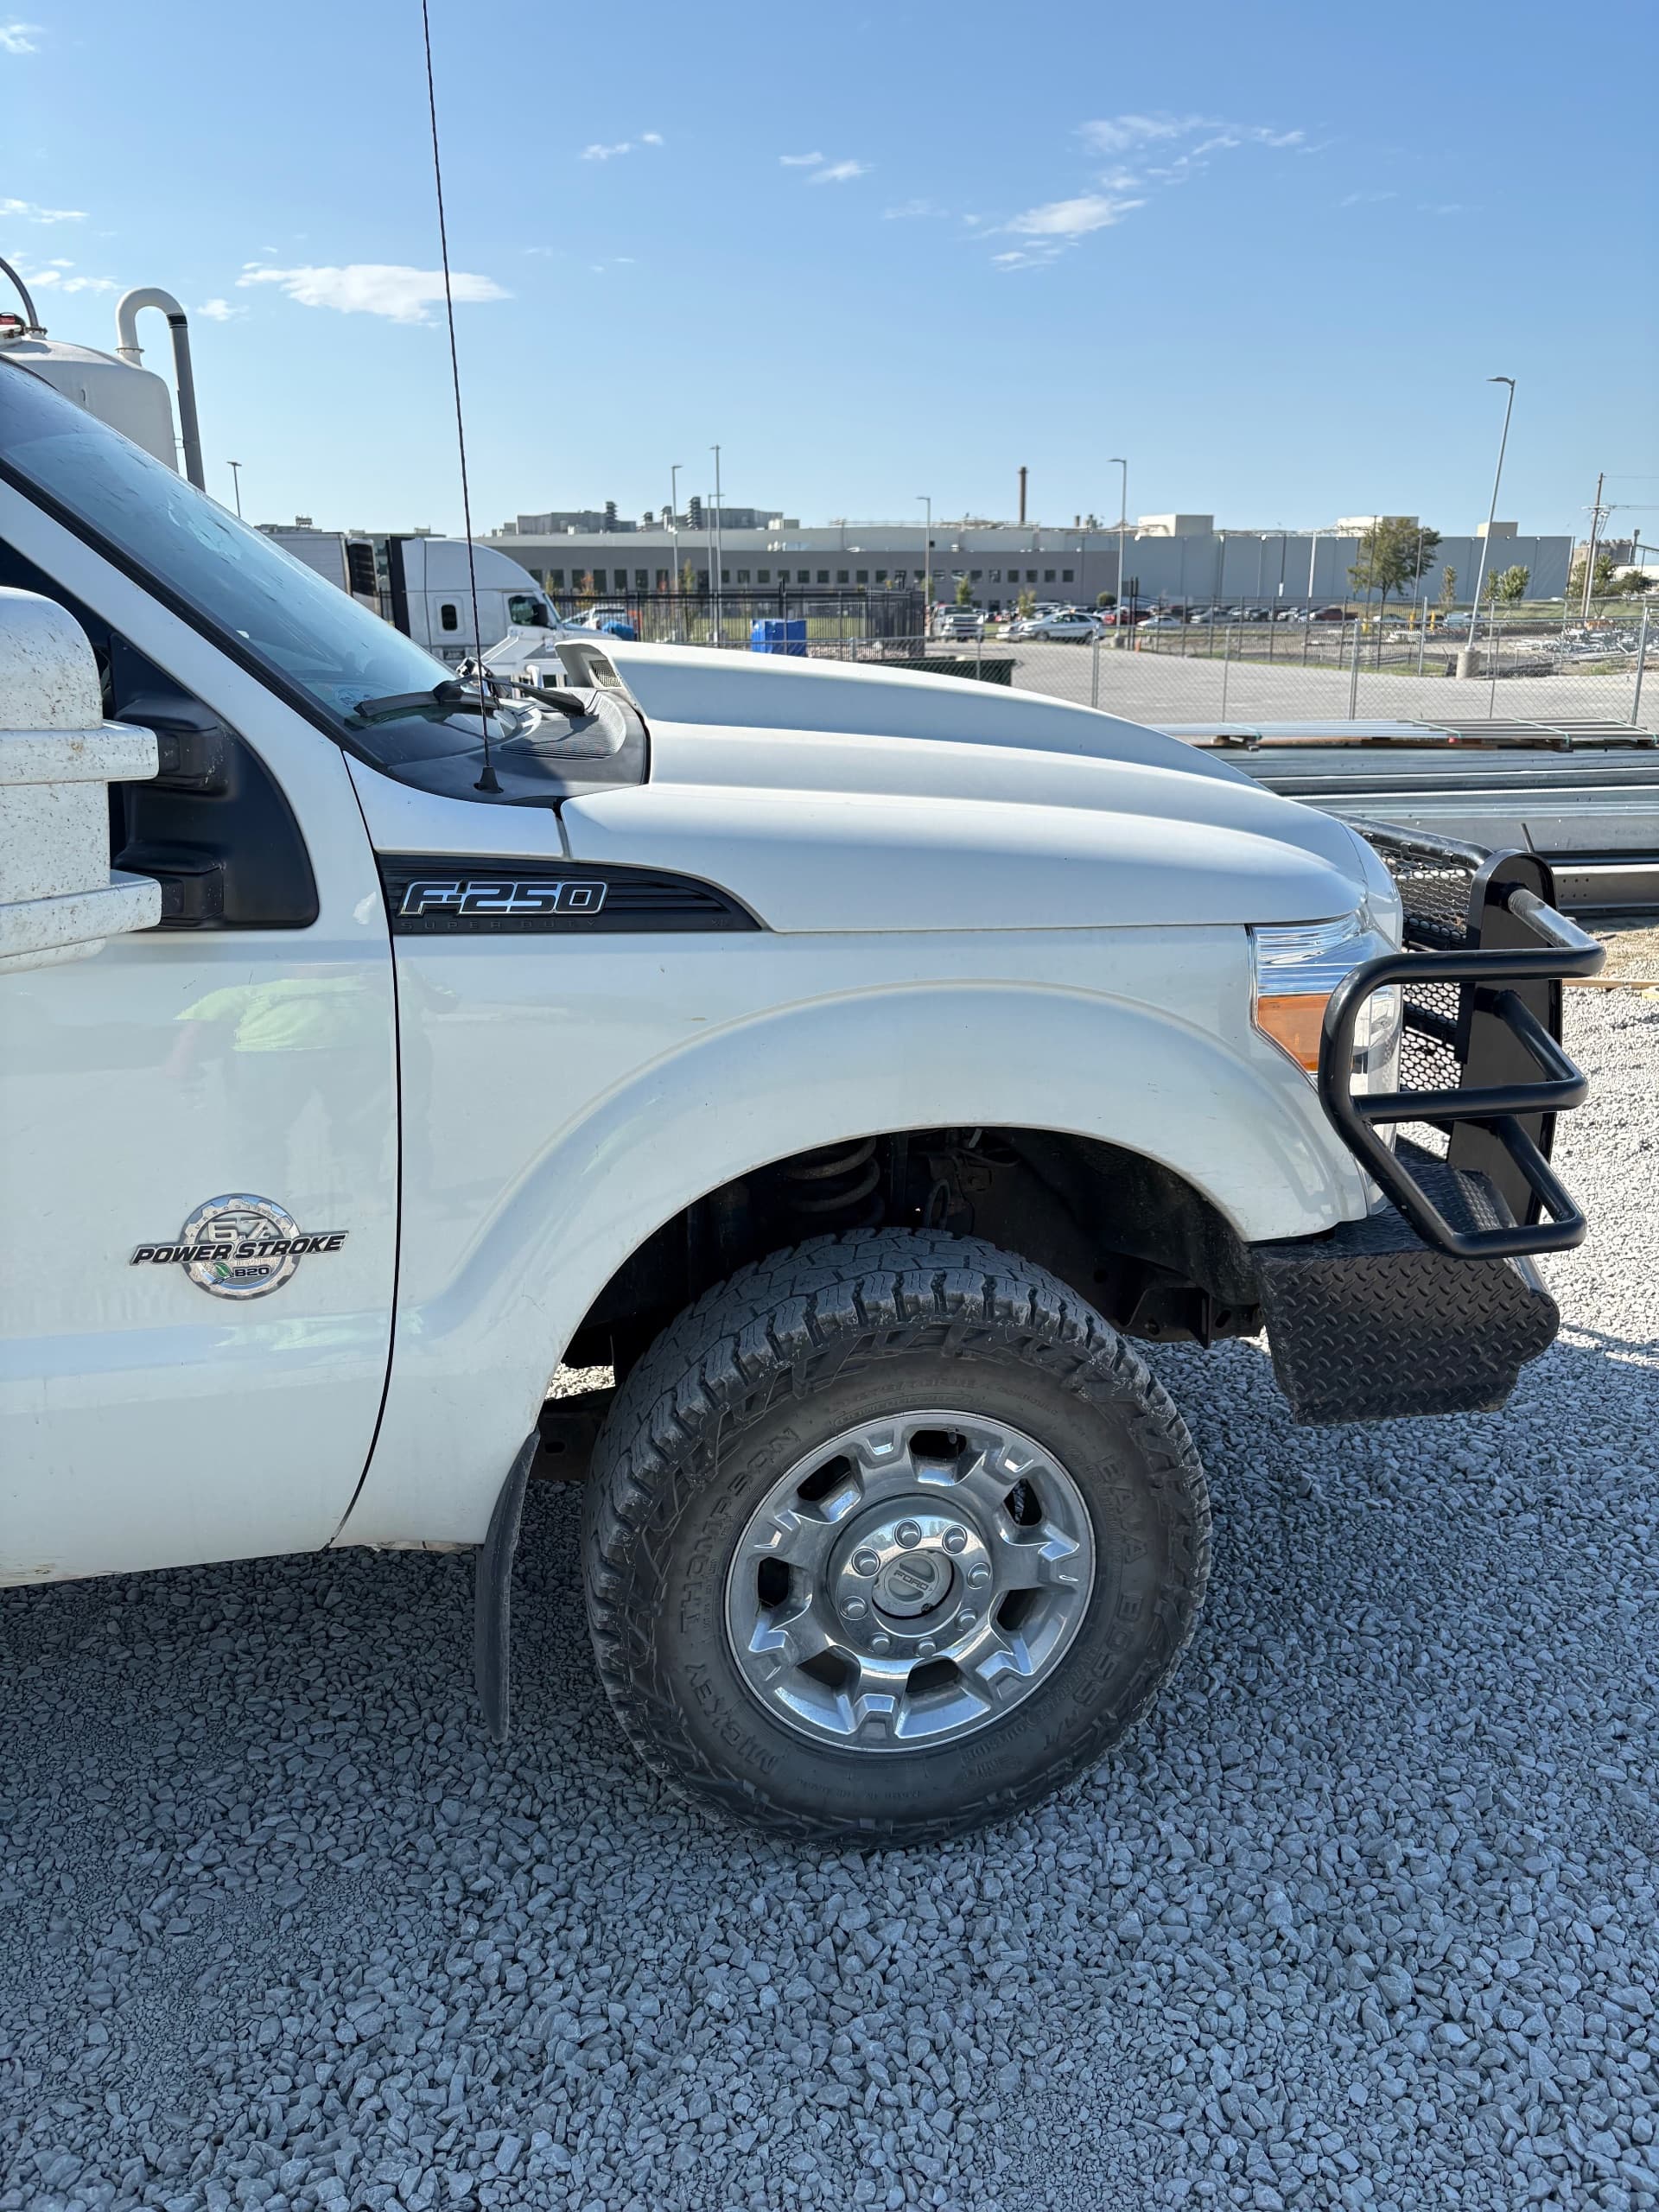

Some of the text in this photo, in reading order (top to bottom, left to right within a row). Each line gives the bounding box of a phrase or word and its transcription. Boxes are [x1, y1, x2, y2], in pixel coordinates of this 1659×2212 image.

[398, 879, 609, 916] F-250
[400, 918, 597, 931] SUPER DUTY
[130, 1231, 347, 1266] POWER STROKE
[234, 1267, 270, 1278] B20
[1095, 1452, 1149, 1565] BAJA
[893, 1569, 929, 1591] FORD
[680, 1426, 801, 1775] MICKEY THOMPSON
[1073, 1592, 1145, 1707] BOSS
